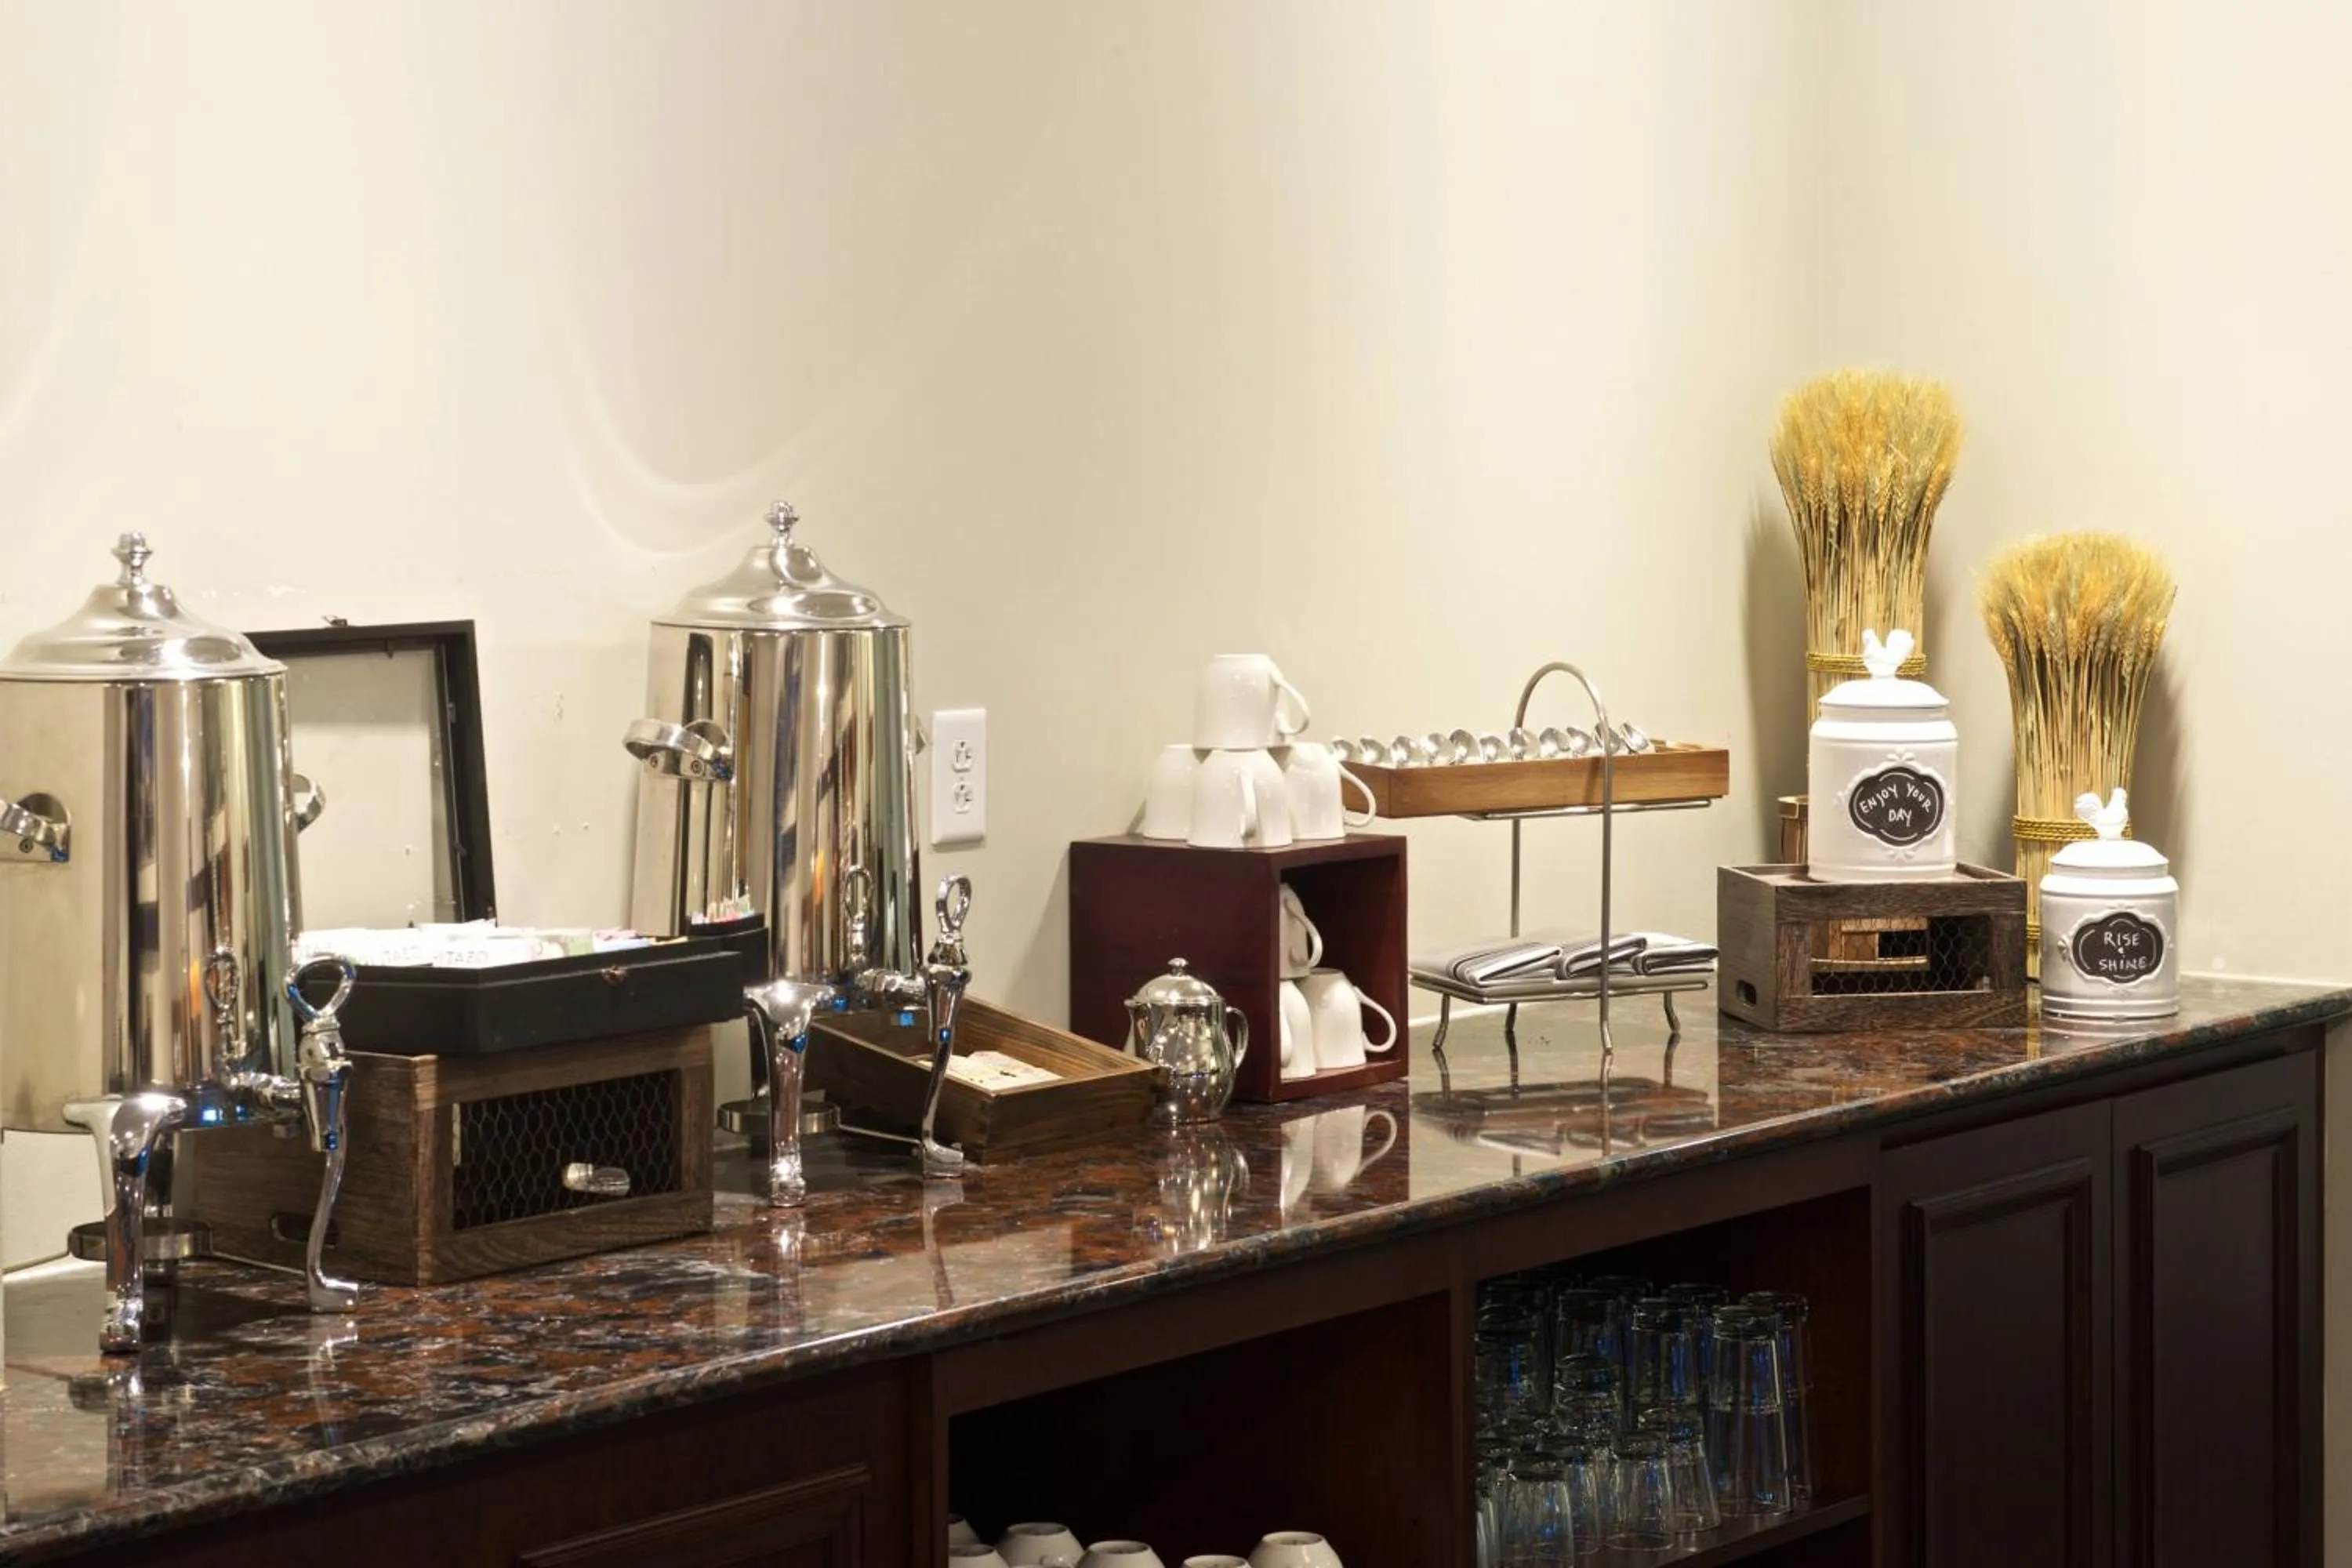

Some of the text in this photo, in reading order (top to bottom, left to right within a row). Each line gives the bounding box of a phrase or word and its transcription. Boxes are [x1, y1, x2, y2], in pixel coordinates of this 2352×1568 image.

[1860, 784, 1898, 813] ENJOY
[1889, 808, 1911, 827] DAY
[2103, 931, 2140, 947] RISE
[2099, 956, 2147, 971] SHINE
